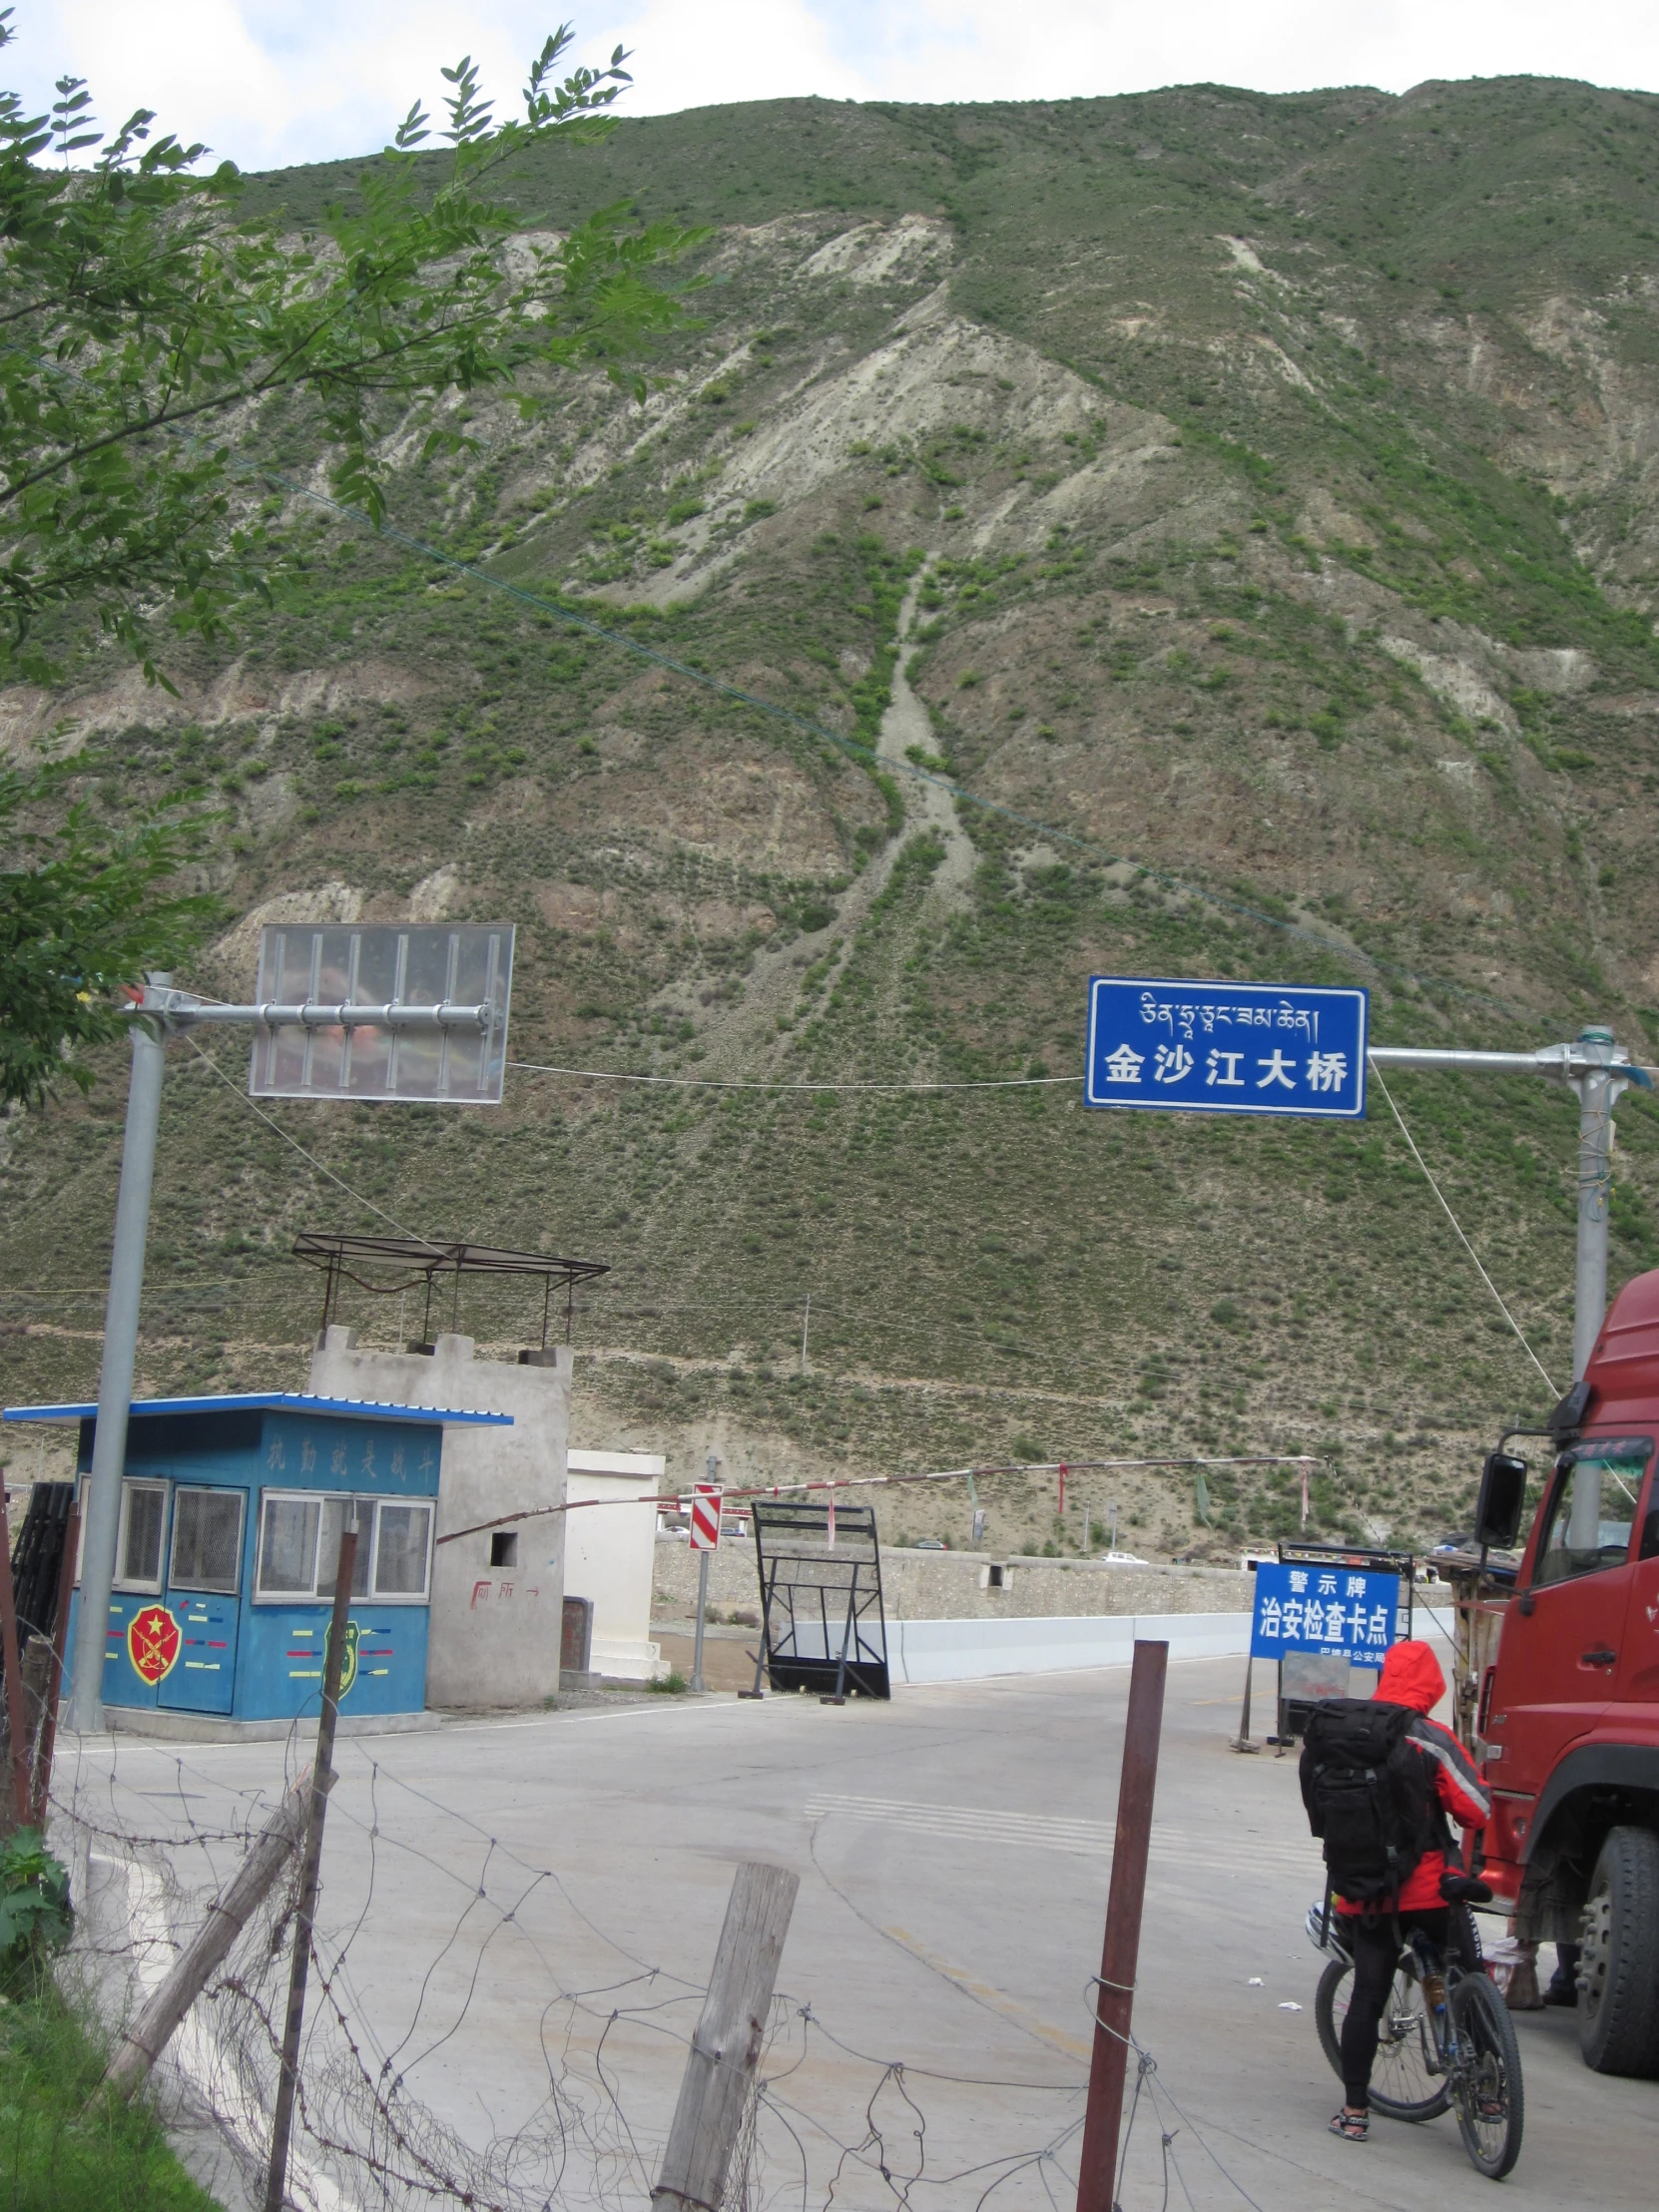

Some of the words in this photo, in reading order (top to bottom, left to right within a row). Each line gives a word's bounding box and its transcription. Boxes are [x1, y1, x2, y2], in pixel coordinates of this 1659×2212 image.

[1104, 1043, 1348, 1092] 金沙江大桥
[268, 1433, 434, 1484] 执勤就是战斗
[1289, 1570, 1367, 1598] 警示牌
[1260, 1596, 1388, 1646] 治安检查卡点
